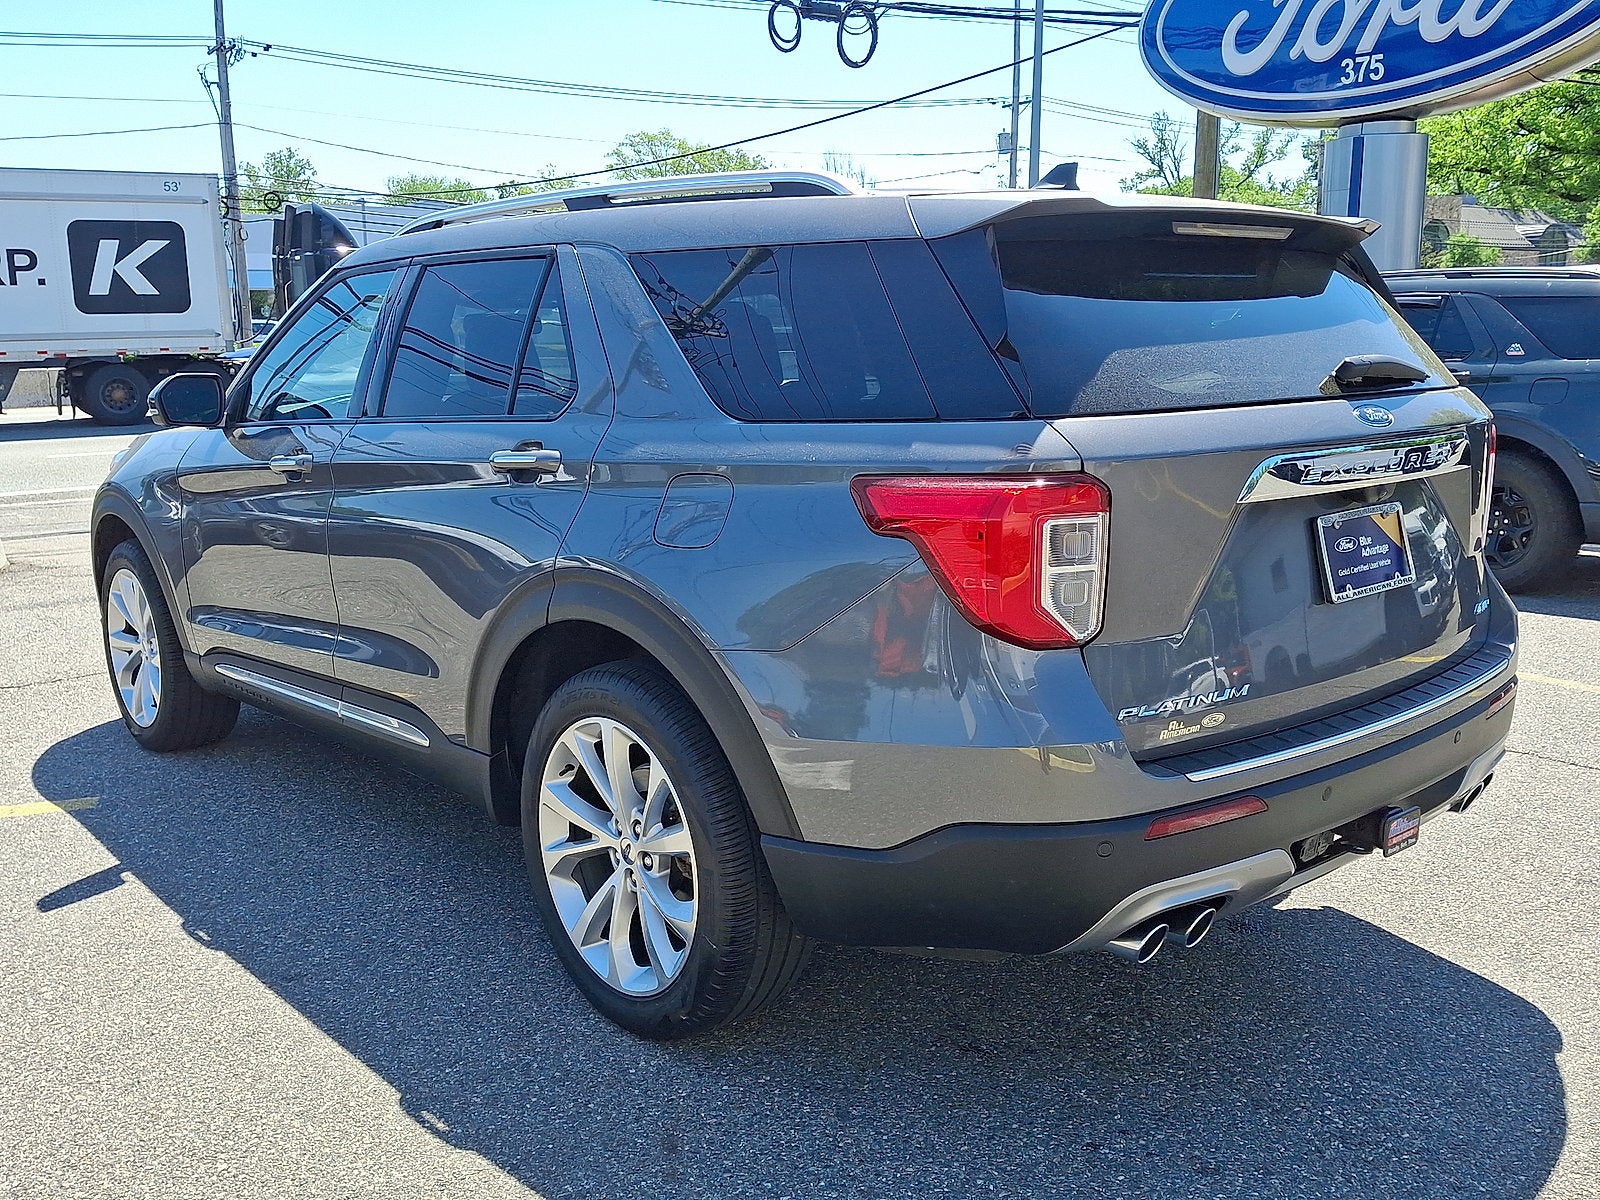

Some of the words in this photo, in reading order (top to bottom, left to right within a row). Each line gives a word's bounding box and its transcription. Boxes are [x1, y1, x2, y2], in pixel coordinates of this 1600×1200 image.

[1340, 53, 1385, 85] 375
[163, 181, 182, 192] 53'
[0, 248, 47, 286] P.
[88, 239, 171, 296] K
[1299, 446, 1455, 486] EXPLORER
[1338, 538, 1355, 551] Ford
[1359, 535, 1373, 547] Blue
[1361, 543, 1390, 558] Advantage
[1338, 567, 1351, 577] Gold
[1350, 562, 1370, 574] Certified
[1335, 592, 1350, 602] ALL
[1352, 582, 1392, 599] AMERICAN
[1392, 576, 1414, 588] FORD
[1117, 683, 1250, 721] PLATINUM
